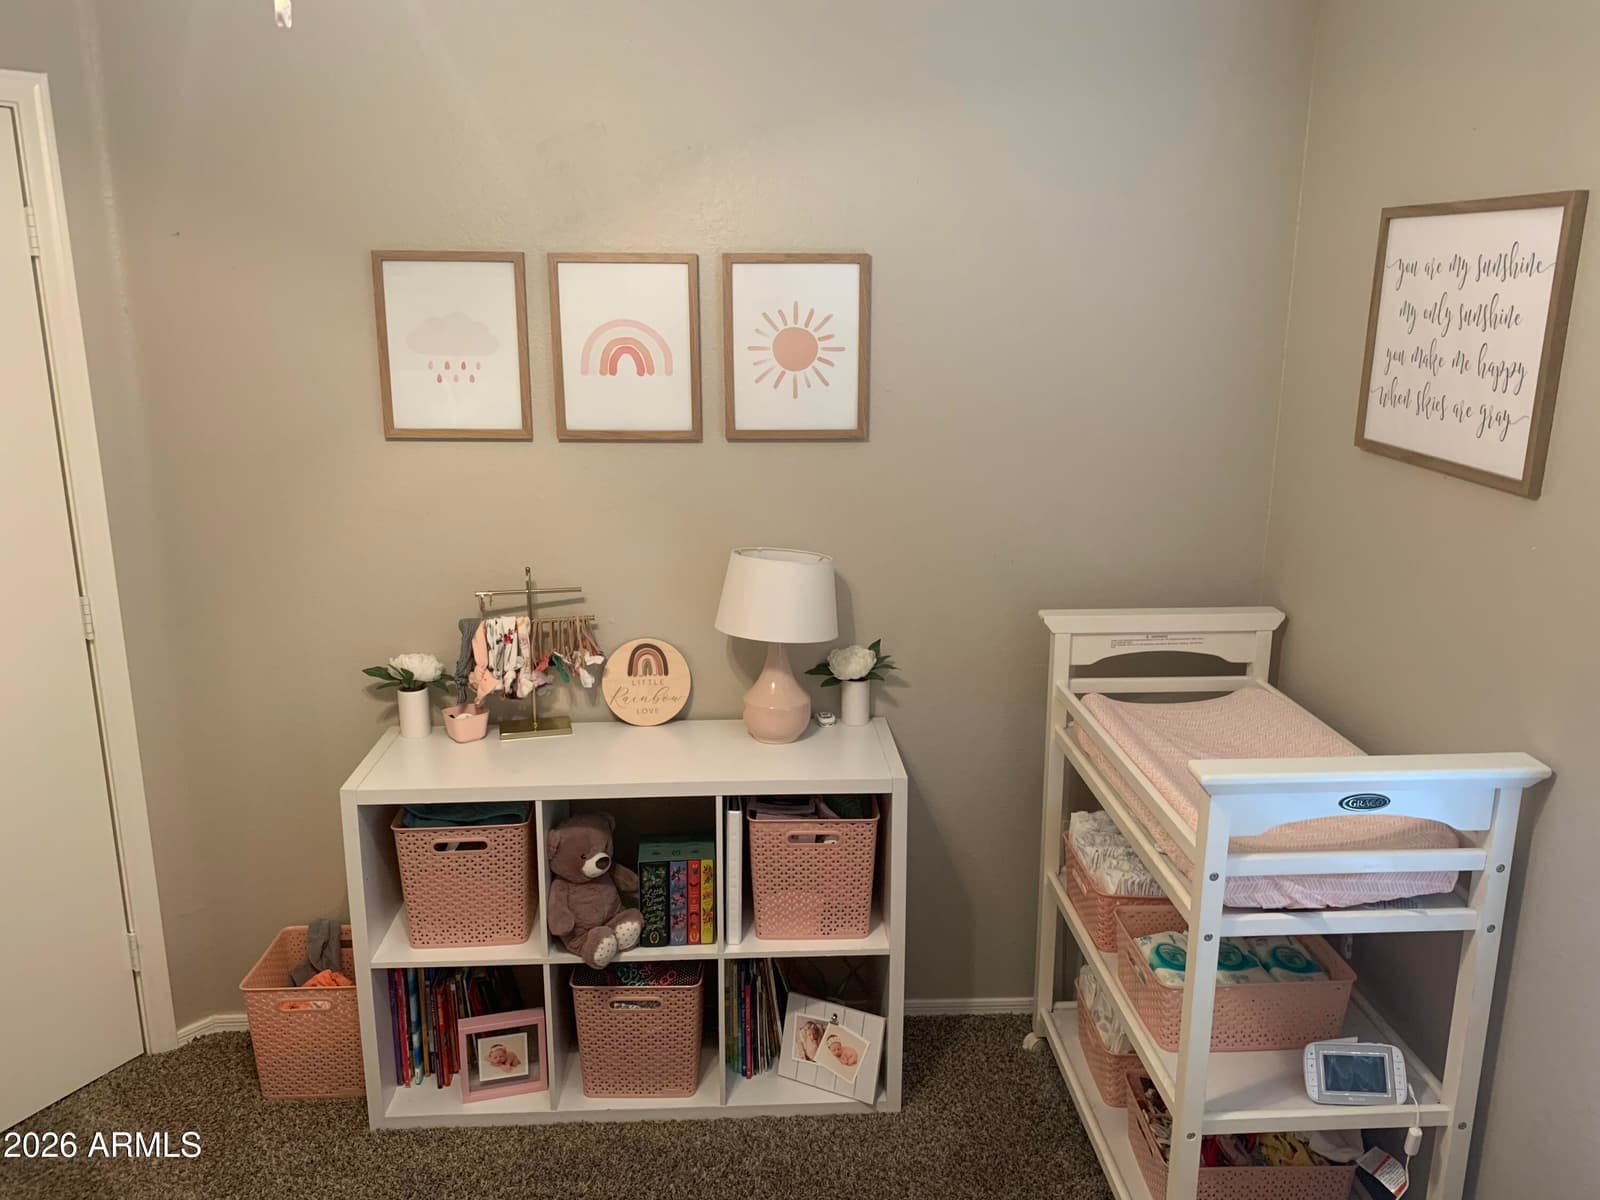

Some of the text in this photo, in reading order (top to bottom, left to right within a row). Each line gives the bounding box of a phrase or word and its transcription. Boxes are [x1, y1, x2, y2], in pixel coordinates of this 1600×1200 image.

[1386, 240, 1558, 291] you are my sunshine
[1400, 291, 1522, 338] my only sunshine
[1384, 337, 1528, 396] you make me happy
[1370, 376, 1530, 442] when skies are gray
[1349, 799, 1383, 807] GRACO
